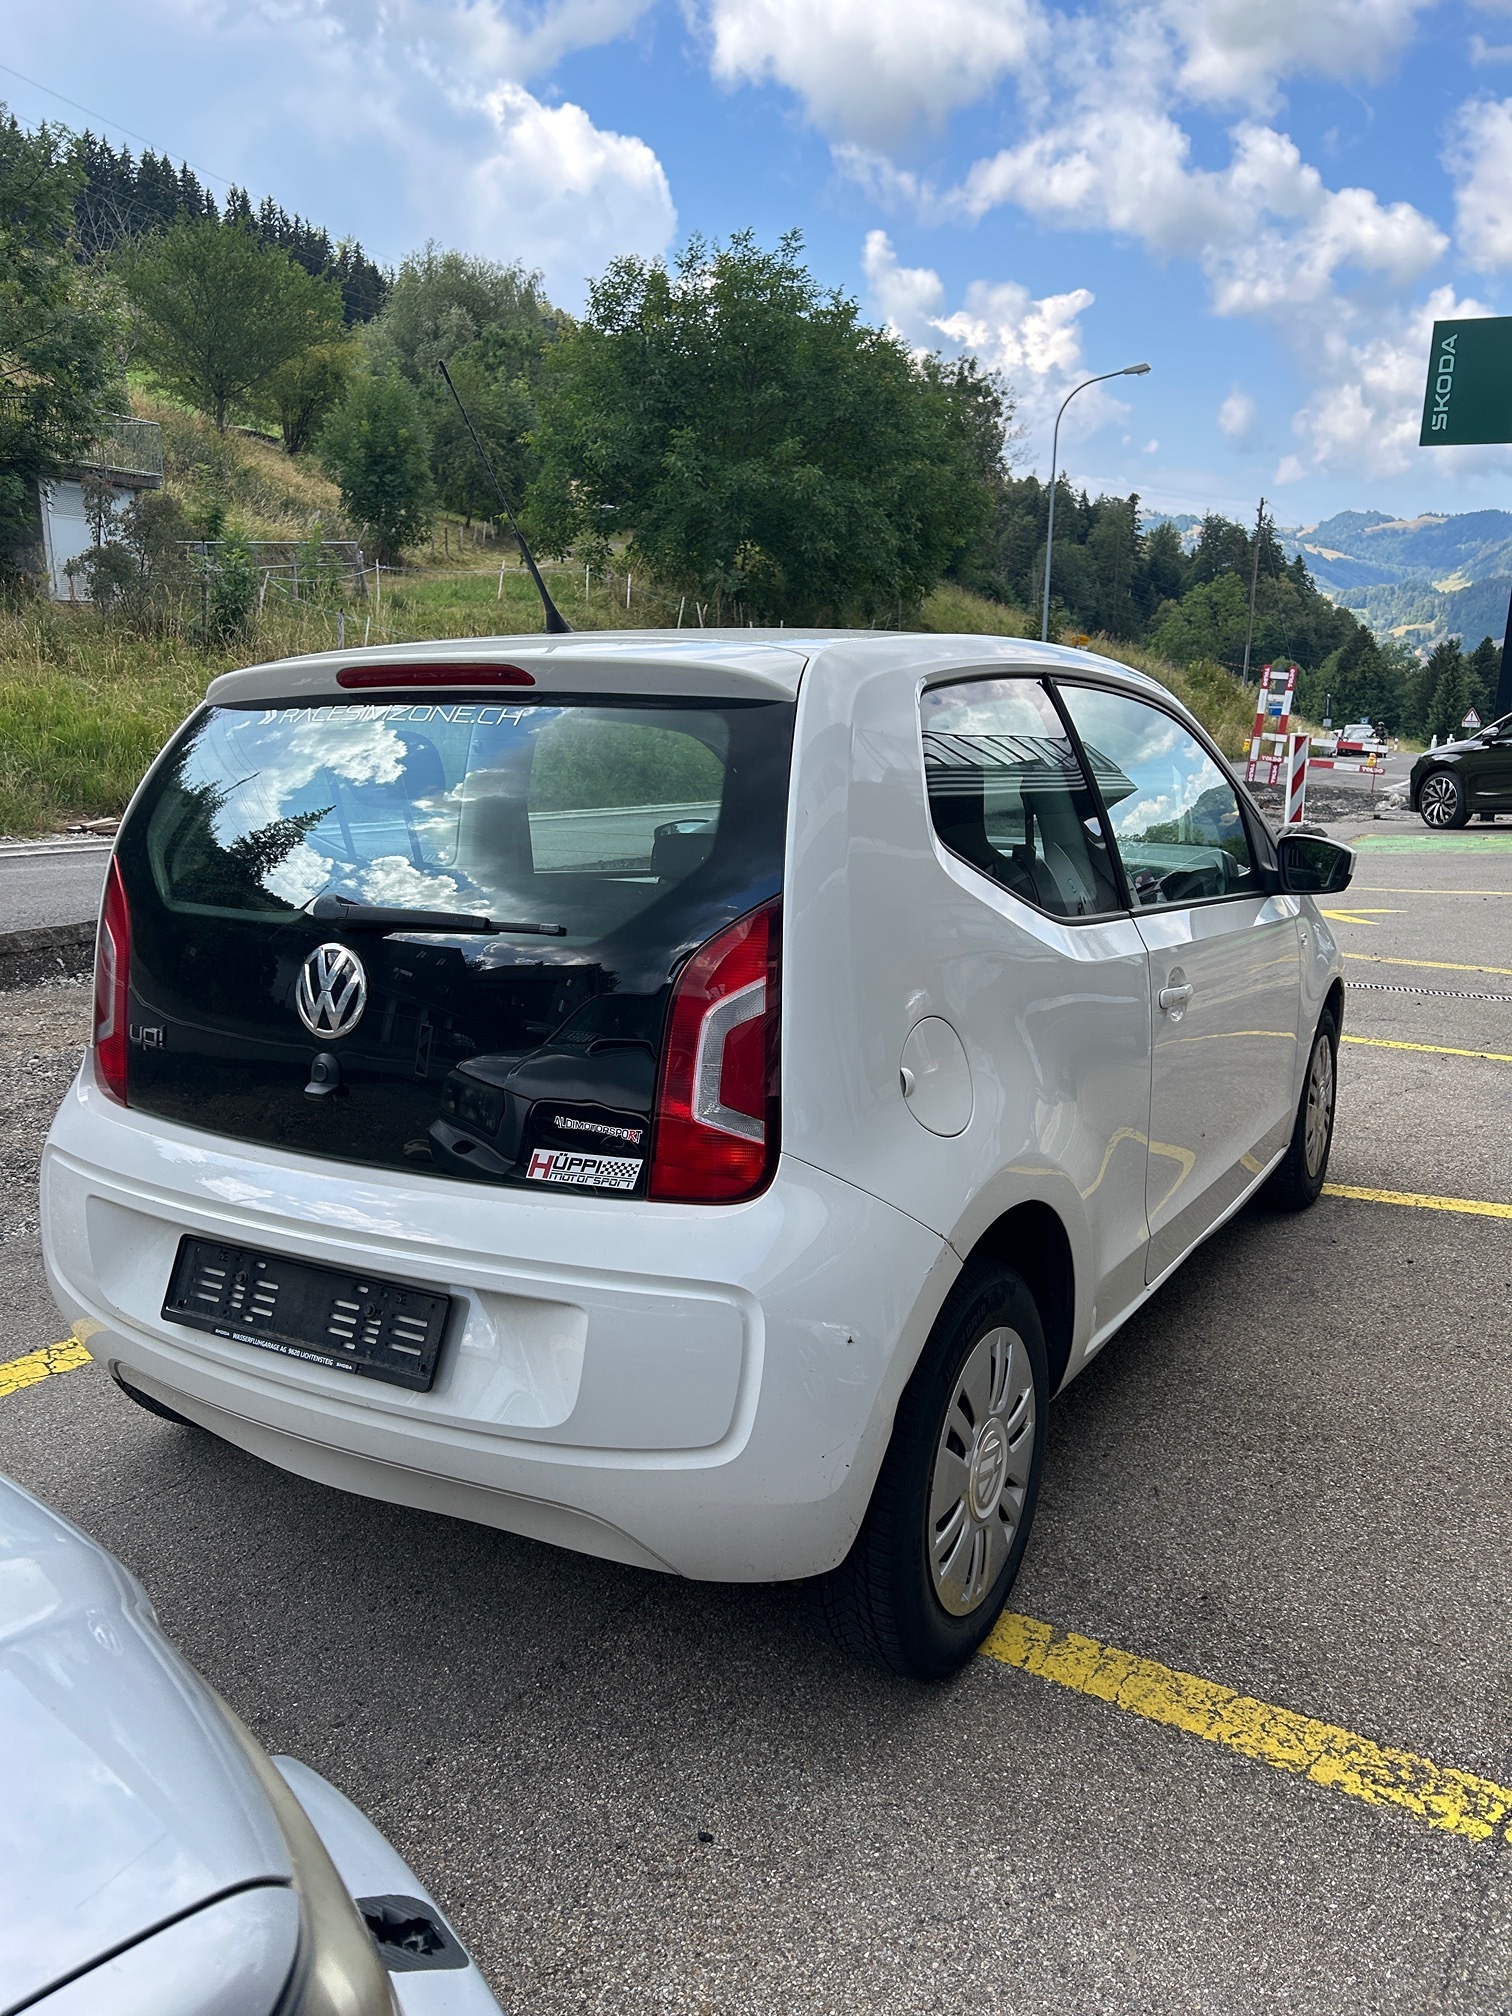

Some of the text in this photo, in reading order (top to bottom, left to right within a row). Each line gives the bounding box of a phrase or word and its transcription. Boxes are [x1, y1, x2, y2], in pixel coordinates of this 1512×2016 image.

[278, 704, 525, 727] RACESIMZONE.CH
[129, 1023, 167, 1050] up!
[527, 1153, 603, 1179] HÜPPI
[280, 1345, 287, 1353] AG
[300, 1351, 334, 1366] LICHTENSTEIG
